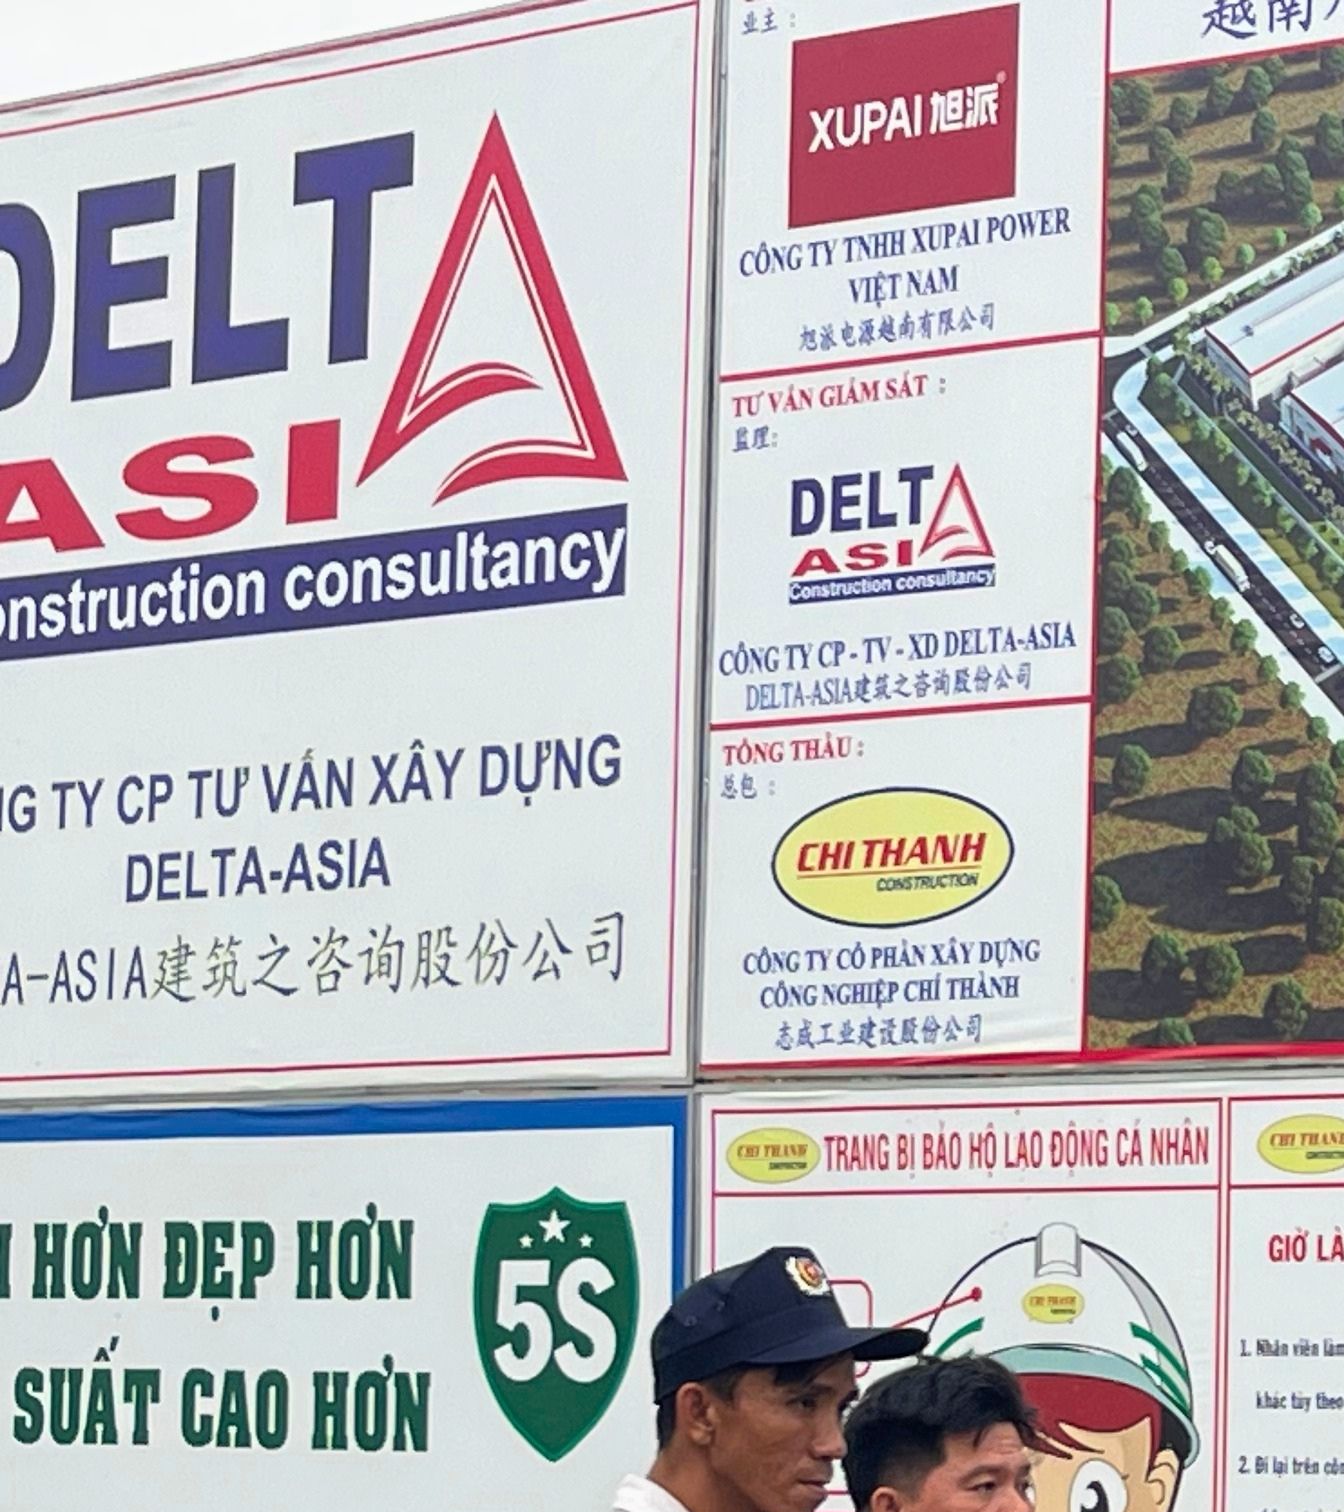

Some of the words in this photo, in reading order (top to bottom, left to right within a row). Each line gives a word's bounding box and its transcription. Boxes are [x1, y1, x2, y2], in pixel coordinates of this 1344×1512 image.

[808, 94, 923, 152] XUPAI
[929, 82, 999, 134] 旭派
[739, 239, 803, 277] CÔNG
[808, 240, 837, 267] TY
[844, 229, 906, 263] TNHH
[911, 219, 981, 254] XUPAI
[987, 207, 1071, 244] POWER
[848, 271, 902, 308] VIỆT
[906, 265, 960, 296] NAM
[732, 396, 764, 418] TƯ
[769, 384, 814, 413] VẤN
[819, 377, 880, 408] GIÁM
[886, 370, 928, 397] SÁT
[0, 563, 265, 642] nstruction
[284, 525, 626, 611] consultancy
[790, 577, 892, 602] Construction
[896, 566, 996, 593] consultancy
[719, 641, 779, 676] CÔNG
[784, 645, 813, 671] TY
[818, 641, 845, 668] CP
[863, 637, 892, 663] TV
[908, 634, 939, 661] XD
[945, 621, 1076, 656] DELTA-ASIA
[724, 737, 784, 766] TỔNG
[791, 732, 852, 762] THẦU
[52, 778, 104, 830] TY
[117, 774, 173, 825] CP
[188, 767, 249, 820] TƯ
[262, 747, 355, 812] VẤN
[368, 739, 466, 805] XÂY
[480, 733, 622, 808] DỰNG
[125, 837, 391, 903] DELTA-ASIA
[797, 840, 854, 873] CHI
[862, 832, 987, 869] THANH
[876, 872, 980, 893] CONSTRUCTION
[743, 946, 799, 975] CÔNG
[805, 950, 833, 972] TY
[836, 941, 865, 970] CỔ
[871, 938, 926, 968] PHẦN
[931, 937, 973, 966] XÂY
[979, 937, 1041, 969] DỰNG
[760, 980, 817, 1009] CÔNG
[822, 978, 899, 1010] NGHIỆP
[904, 974, 941, 1002] CHÍ
[946, 971, 1020, 1000] THÀNH
[823, 1133, 889, 1172] TRANG
[897, 1131, 916, 1178] BỊ
[969, 1122, 996, 1177] HỘ
[1004, 1129, 1041, 1168] LAO
[1050, 1121, 1108, 1177] ĐỘNG
[1116, 1120, 1143, 1166] CÁ
[1150, 1116, 1209, 1166] NHÂN
[32, 1205, 142, 1300] HƠN
[164, 1219, 275, 1321] ĐẸP
[295, 1202, 415, 1300] HƠN
[1268, 1228, 1308, 1262] GIỜ
[493, 1256, 618, 1383] 5S
[13, 1336, 161, 1446] SUẤT
[181, 1369, 290, 1451] CAO
[311, 1354, 431, 1454] HƠN
